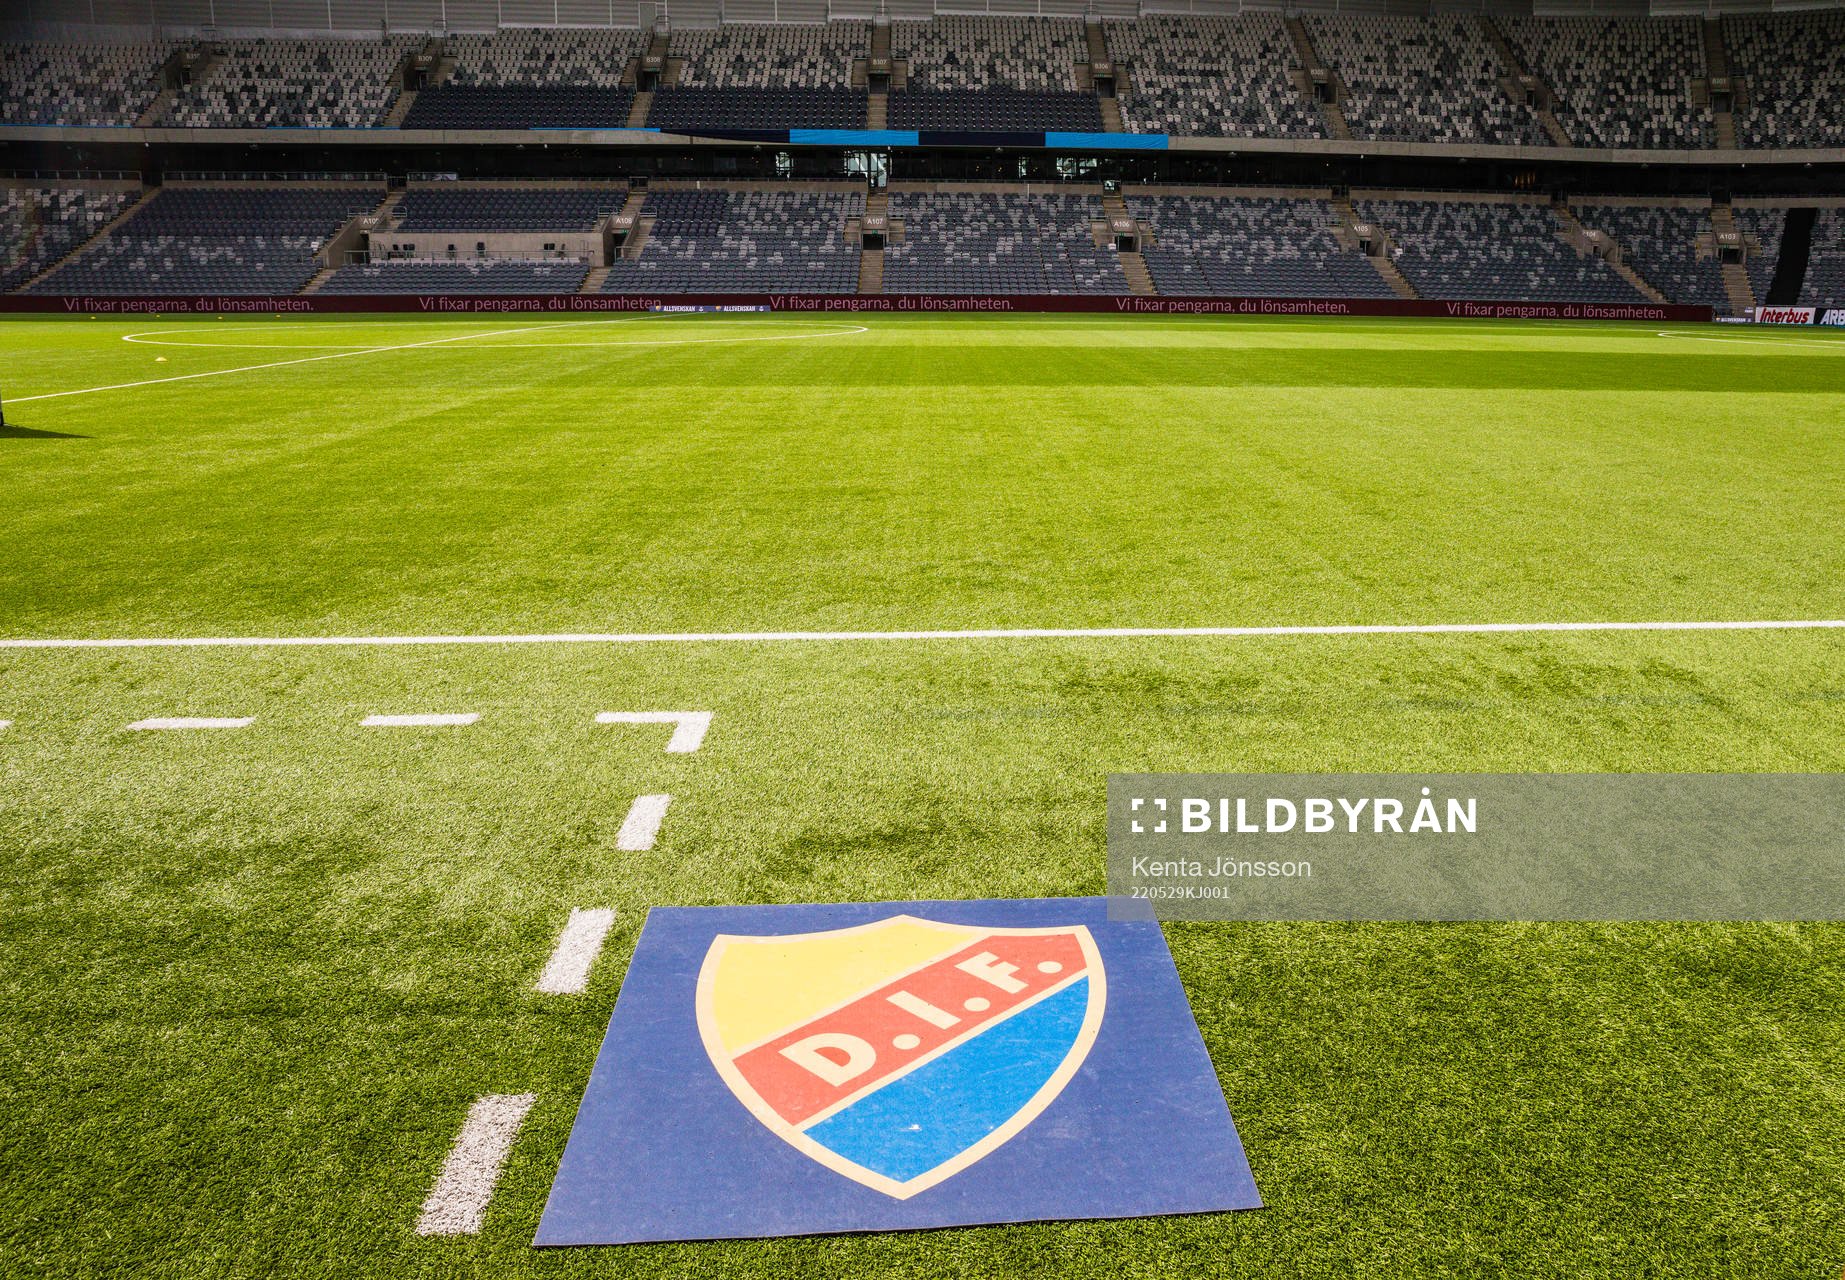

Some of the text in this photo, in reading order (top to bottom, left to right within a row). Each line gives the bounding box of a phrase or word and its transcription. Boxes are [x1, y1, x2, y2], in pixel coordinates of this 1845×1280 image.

[616, 217, 633, 225] A108
[867, 217, 883, 225] A107
[1113, 220, 1130, 228] A106
[1353, 224, 1369, 232] A105
[64, 298, 314, 313] Vi fixar pengarna, du lönsamheten.
[419, 297, 434, 310] Vi
[438, 297, 469, 310] fixar
[474, 298, 544, 312] pengarna,
[548, 296, 566, 310] du
[770, 296, 1013, 312] Vi fixar pengarna, du lönsamheten.
[1116, 298, 1350, 313] Vi fixar pengarna, du lönsamheten.
[1447, 303, 1667, 319] Vi fixar pengarna, du lönsamheten.
[1760, 307, 1810, 324] Interbus
